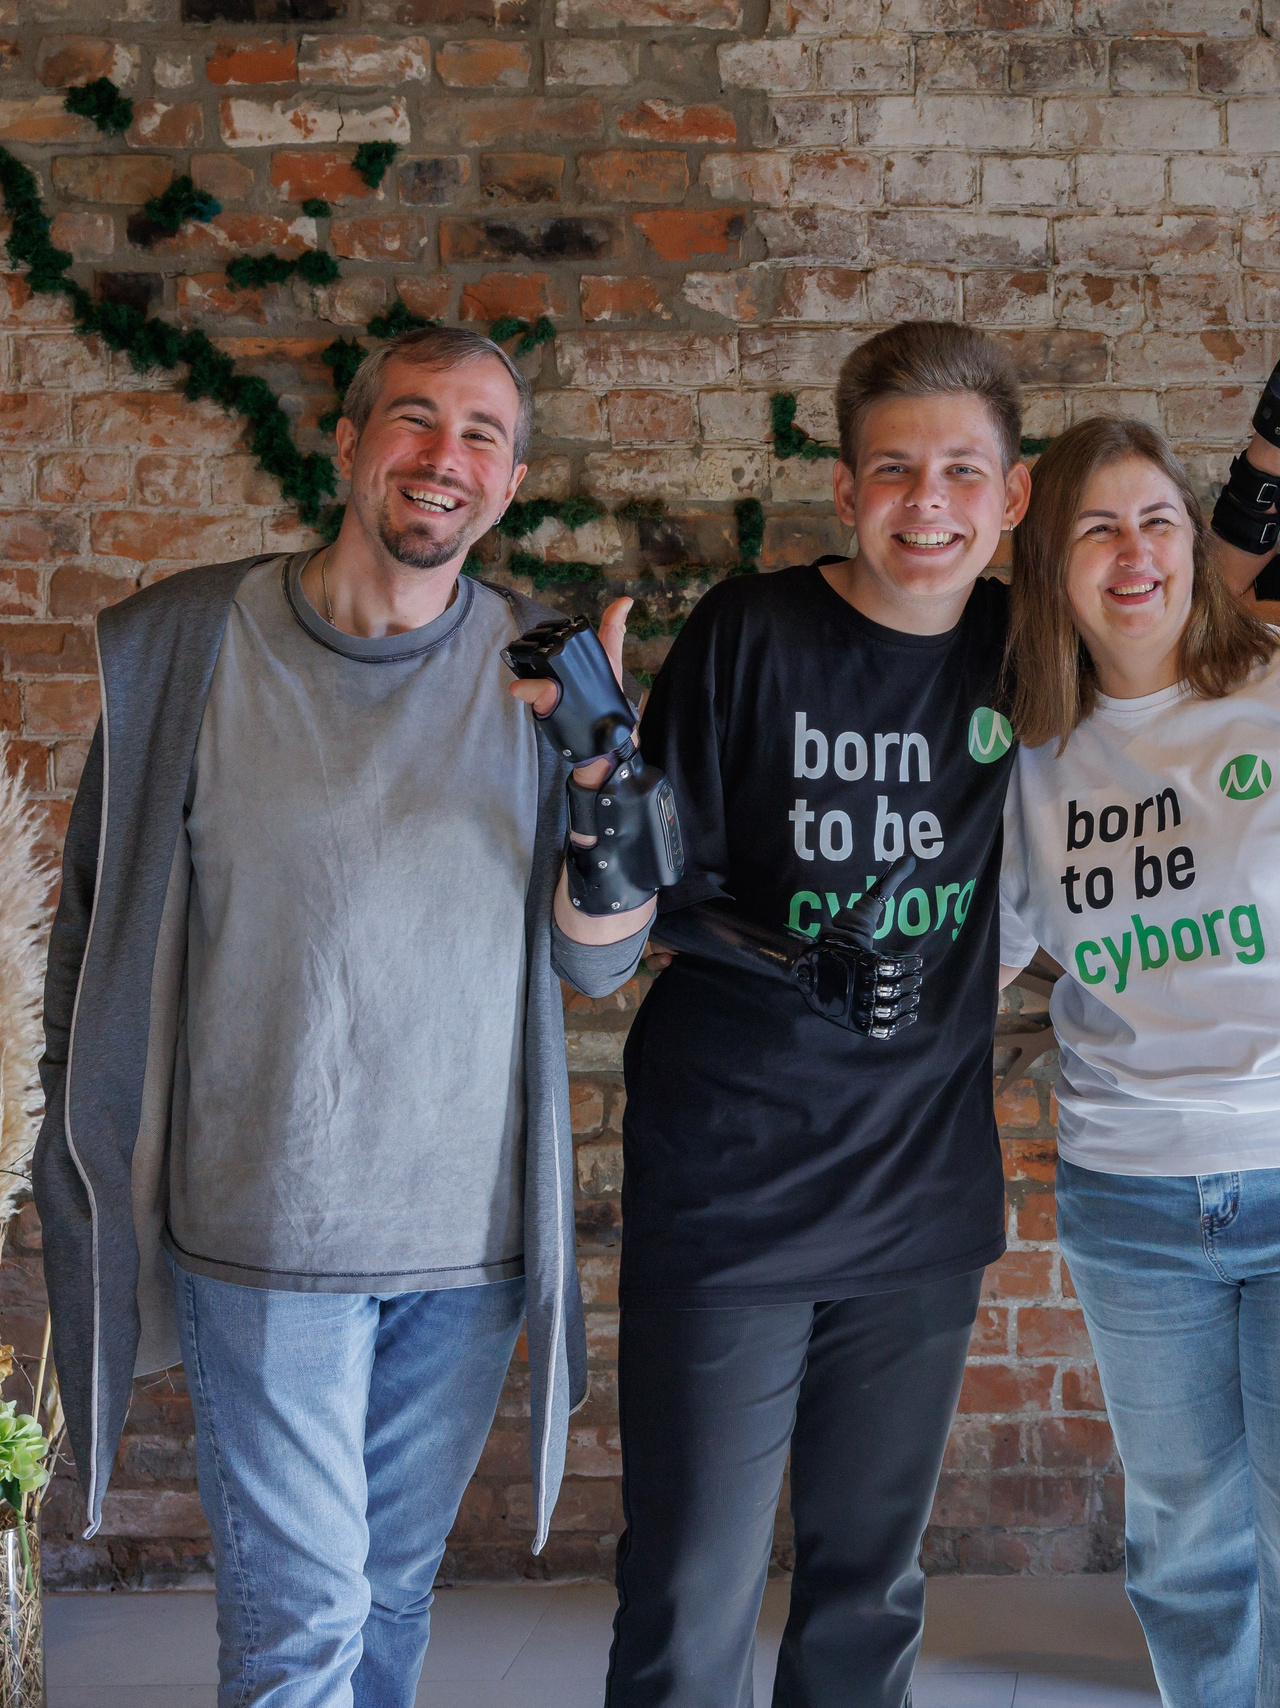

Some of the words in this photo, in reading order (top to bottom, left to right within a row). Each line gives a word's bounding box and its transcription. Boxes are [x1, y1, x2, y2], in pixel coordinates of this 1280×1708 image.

[793, 711, 931, 783] born
[788, 798, 853, 862] to
[873, 795, 945, 862] be
[1066, 787, 1182, 852] born
[1060, 865, 1115, 914] to
[1134, 845, 1197, 900] be
[1074, 903, 1266, 994] cyborg
